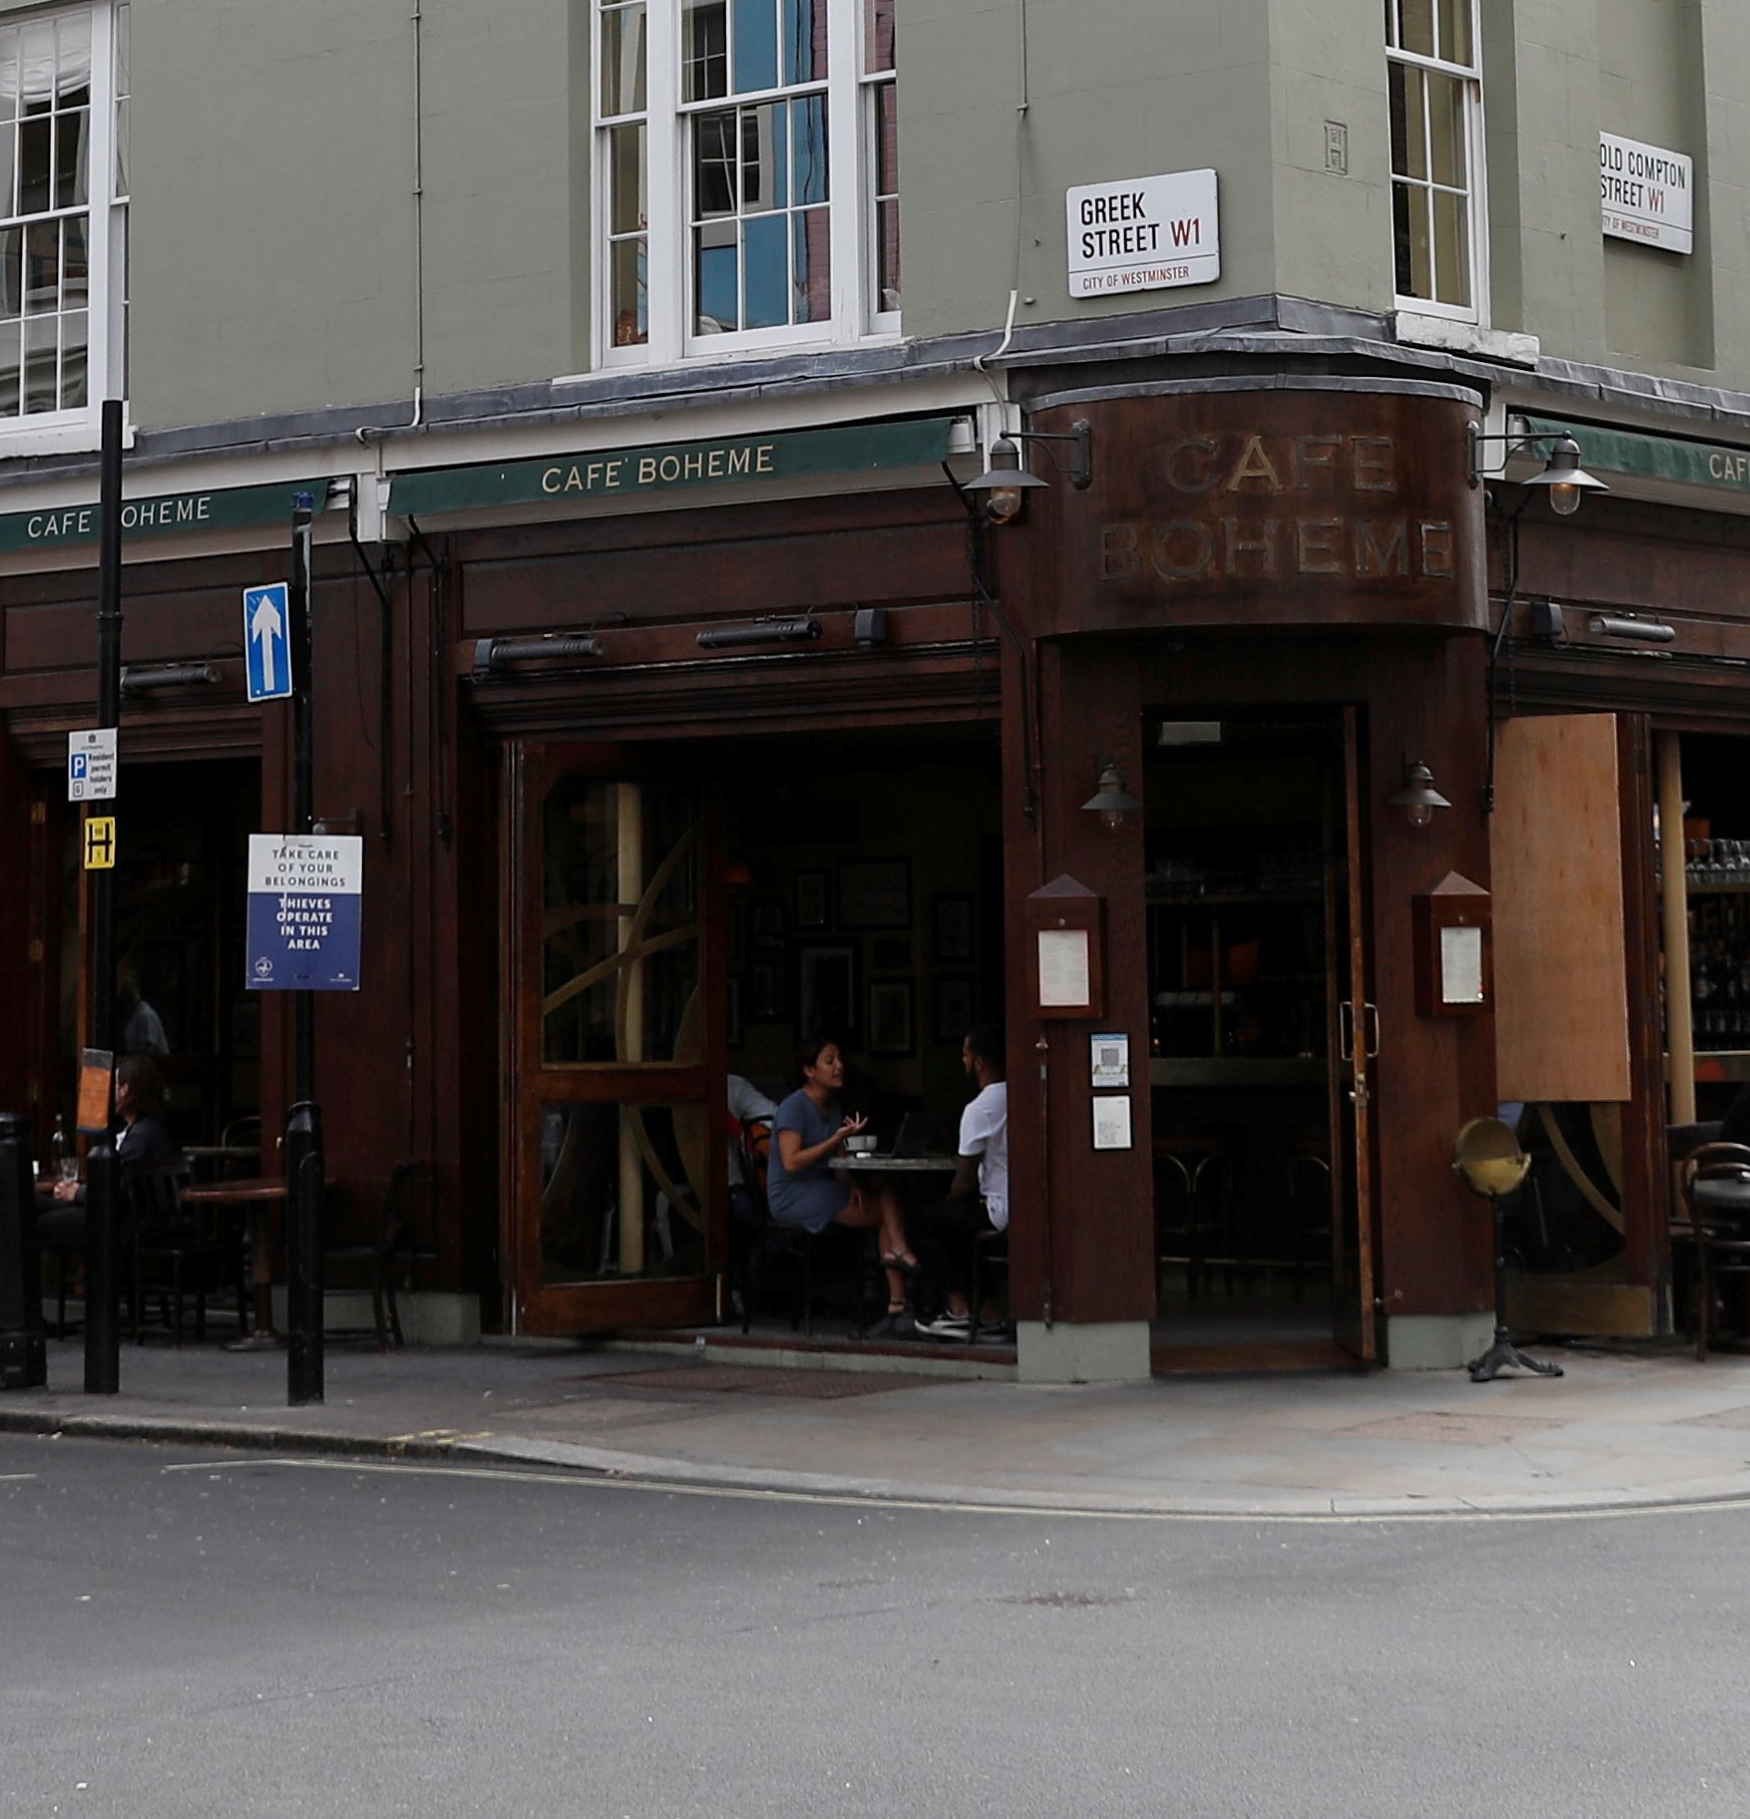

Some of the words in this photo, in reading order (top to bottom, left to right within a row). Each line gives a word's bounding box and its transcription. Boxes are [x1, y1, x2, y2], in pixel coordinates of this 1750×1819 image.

[1599, 143, 1623, 172] OLD
[1628, 151, 1686, 189] COMPTON
[1081, 191, 1146, 226] GREEK
[1600, 174, 1644, 208] STREET
[1648, 186, 1664, 214] W1
[1082, 223, 1160, 259] STREET
[1170, 217, 1200, 248] W1
[1082, 276, 1104, 290] CITY
[1106, 274, 1119, 287] OF
[1121, 266, 1190, 286] WESTMINSTER
[638, 445, 774, 484] BOHEME
[1164, 433, 1398, 493] CAFE
[27, 510, 92, 538] CAFE
[120, 496, 211, 528] OHEME
[1098, 516, 1452, 580] BOHEME
[272, 849, 303, 860] TAKE
[308, 849, 339, 860] CARE
[277, 863, 295, 872] OF
[300, 863, 333, 873] YOUR
[265, 876, 346, 887] BELONGINGS
[276, 912, 333, 923] OPERATE
[278, 898, 331, 909] THIEVES
[280, 925, 295, 936] IN
[299, 925, 328, 936] THIS
[287, 939, 320, 950] AREA
